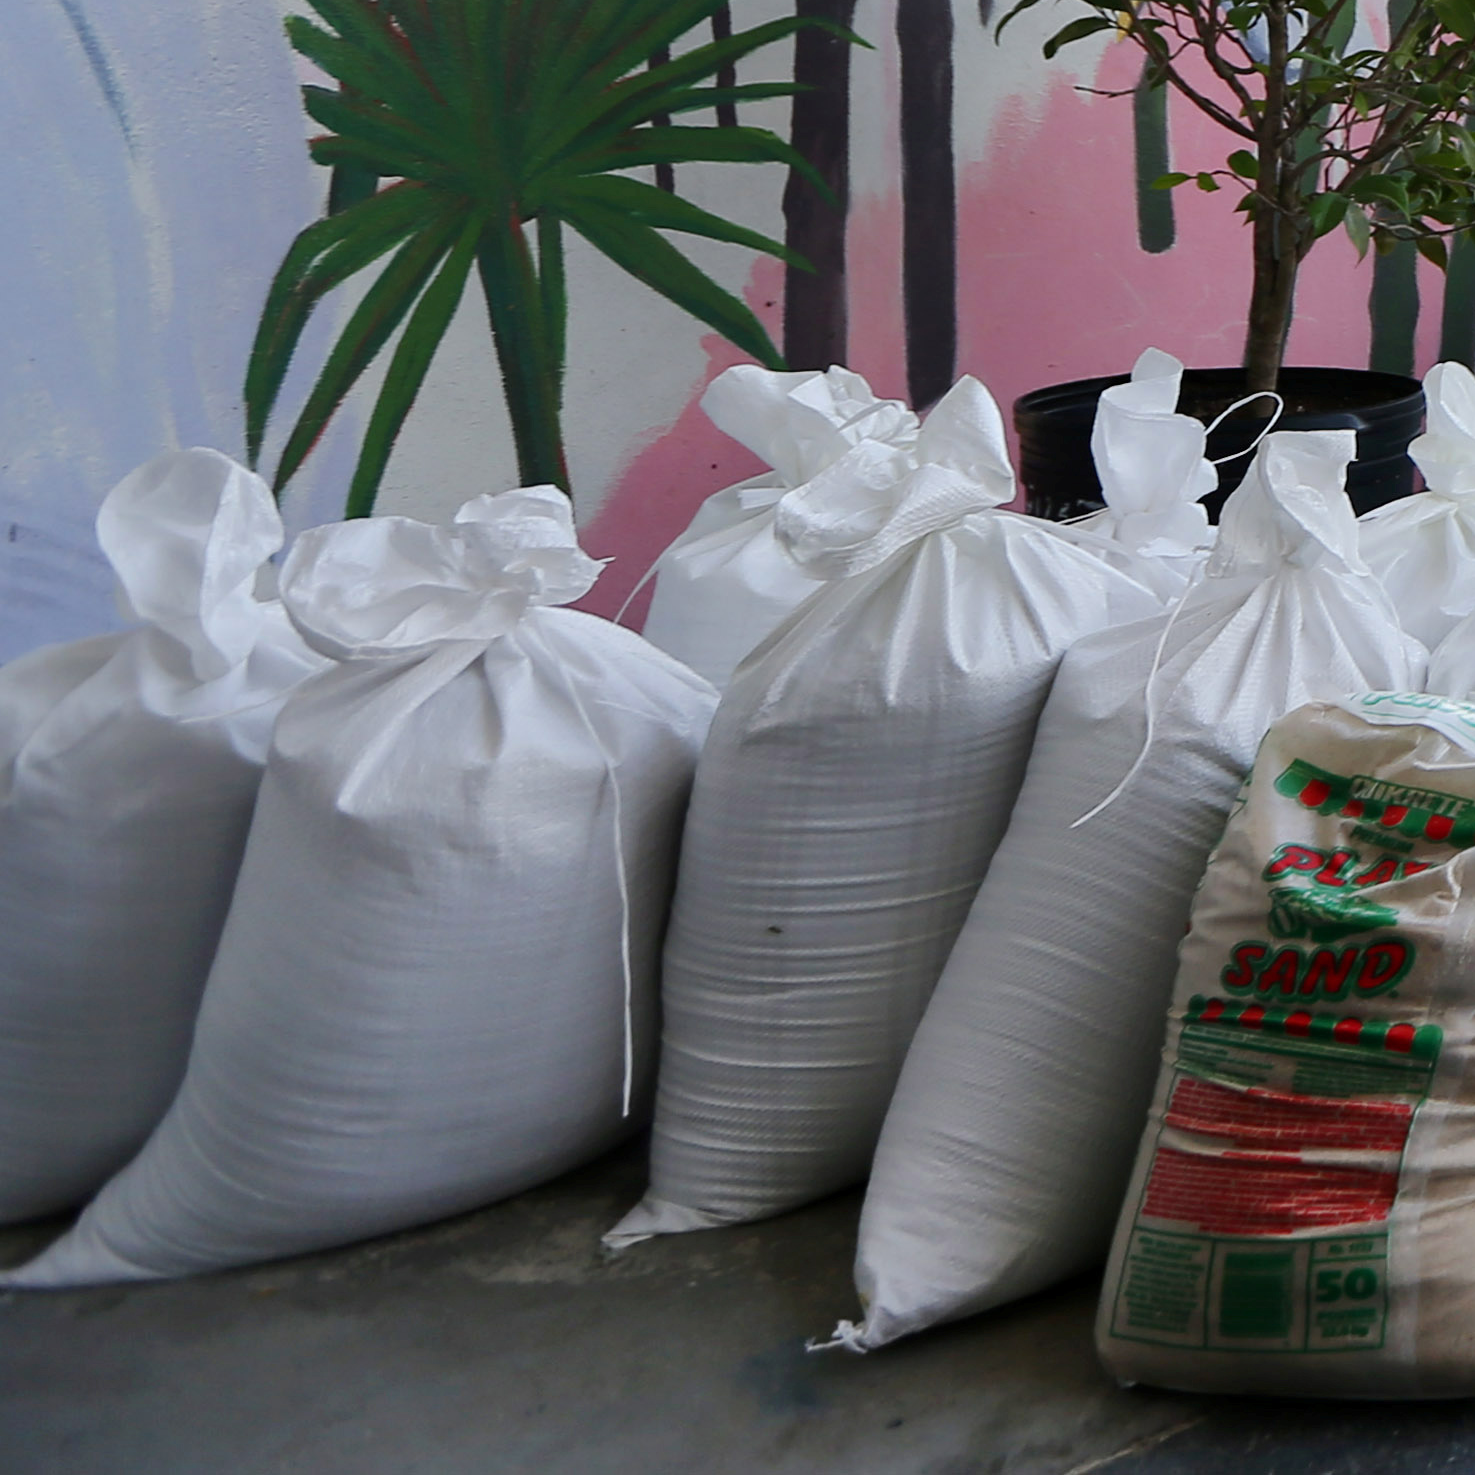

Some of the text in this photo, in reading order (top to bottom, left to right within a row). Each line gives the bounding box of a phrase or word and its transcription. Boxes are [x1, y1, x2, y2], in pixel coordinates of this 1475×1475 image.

[1350, 776, 1470, 817] QUIKRETE
[1220, 938, 1416, 1002] SAND
[1315, 1267, 1378, 1303] 50
